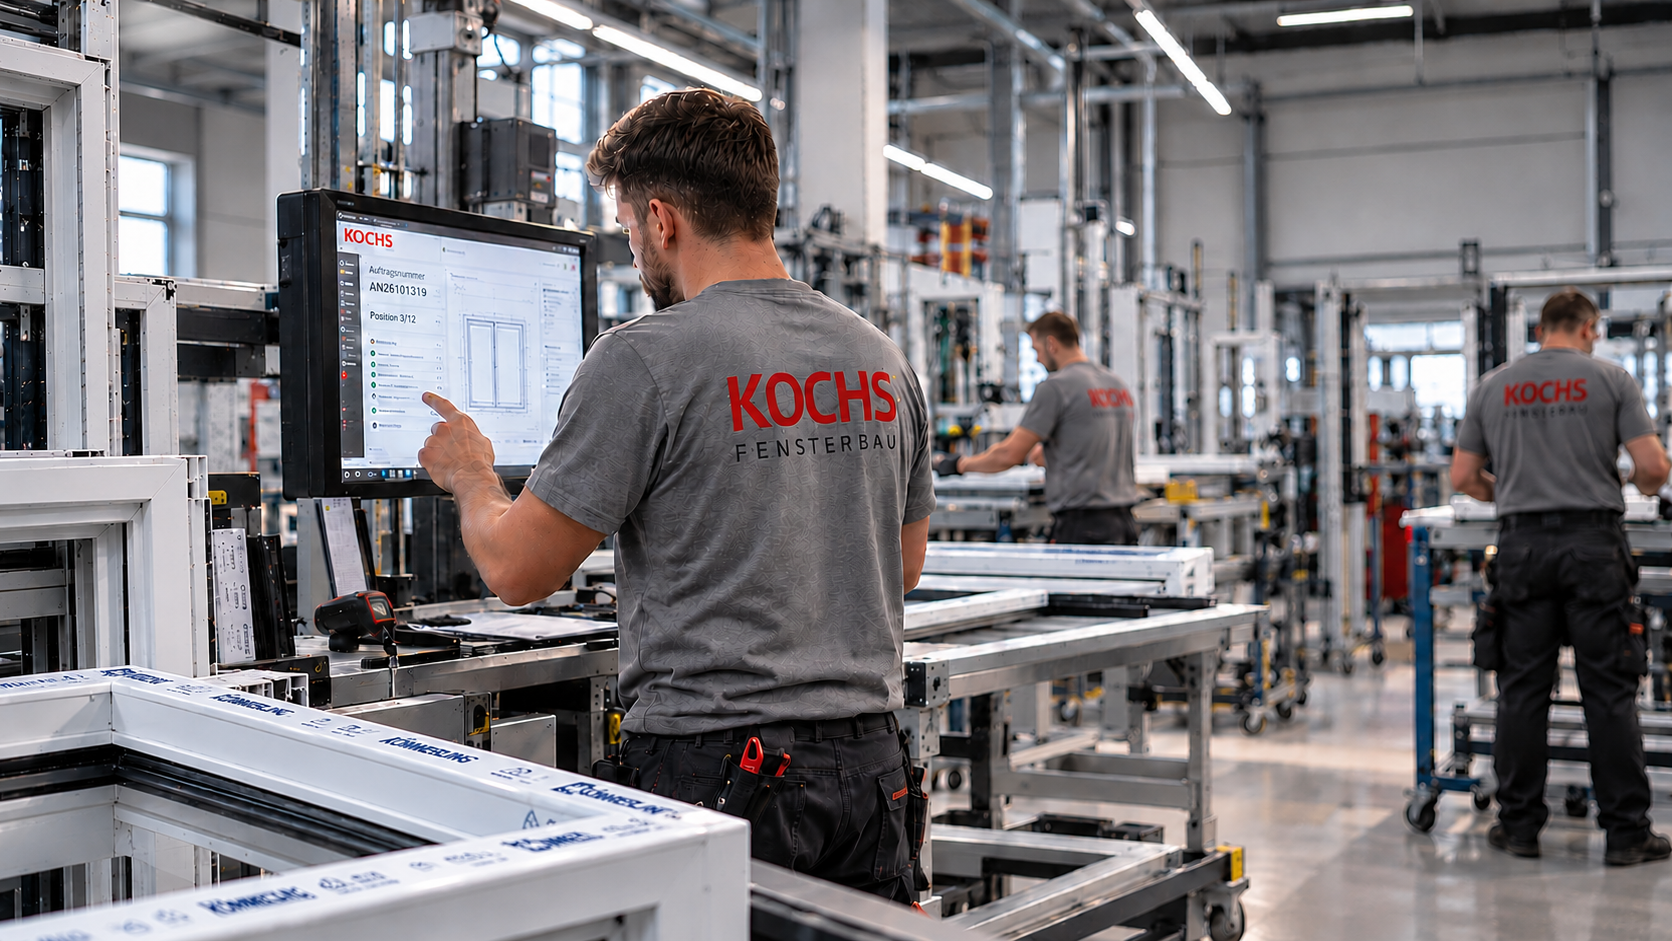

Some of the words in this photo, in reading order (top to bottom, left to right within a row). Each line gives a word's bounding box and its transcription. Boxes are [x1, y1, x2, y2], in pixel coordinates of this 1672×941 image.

[344, 227, 393, 248] KOCHS
[369, 265, 426, 281] Auftragsnummer
[369, 282, 427, 297] AN26101319
[370, 311, 399, 322] Position
[400, 314, 417, 324] 3/12
[726, 371, 897, 432] KOCHS
[1504, 378, 1588, 407] KOCHS
[735, 434, 896, 463] FENSTERBAU
